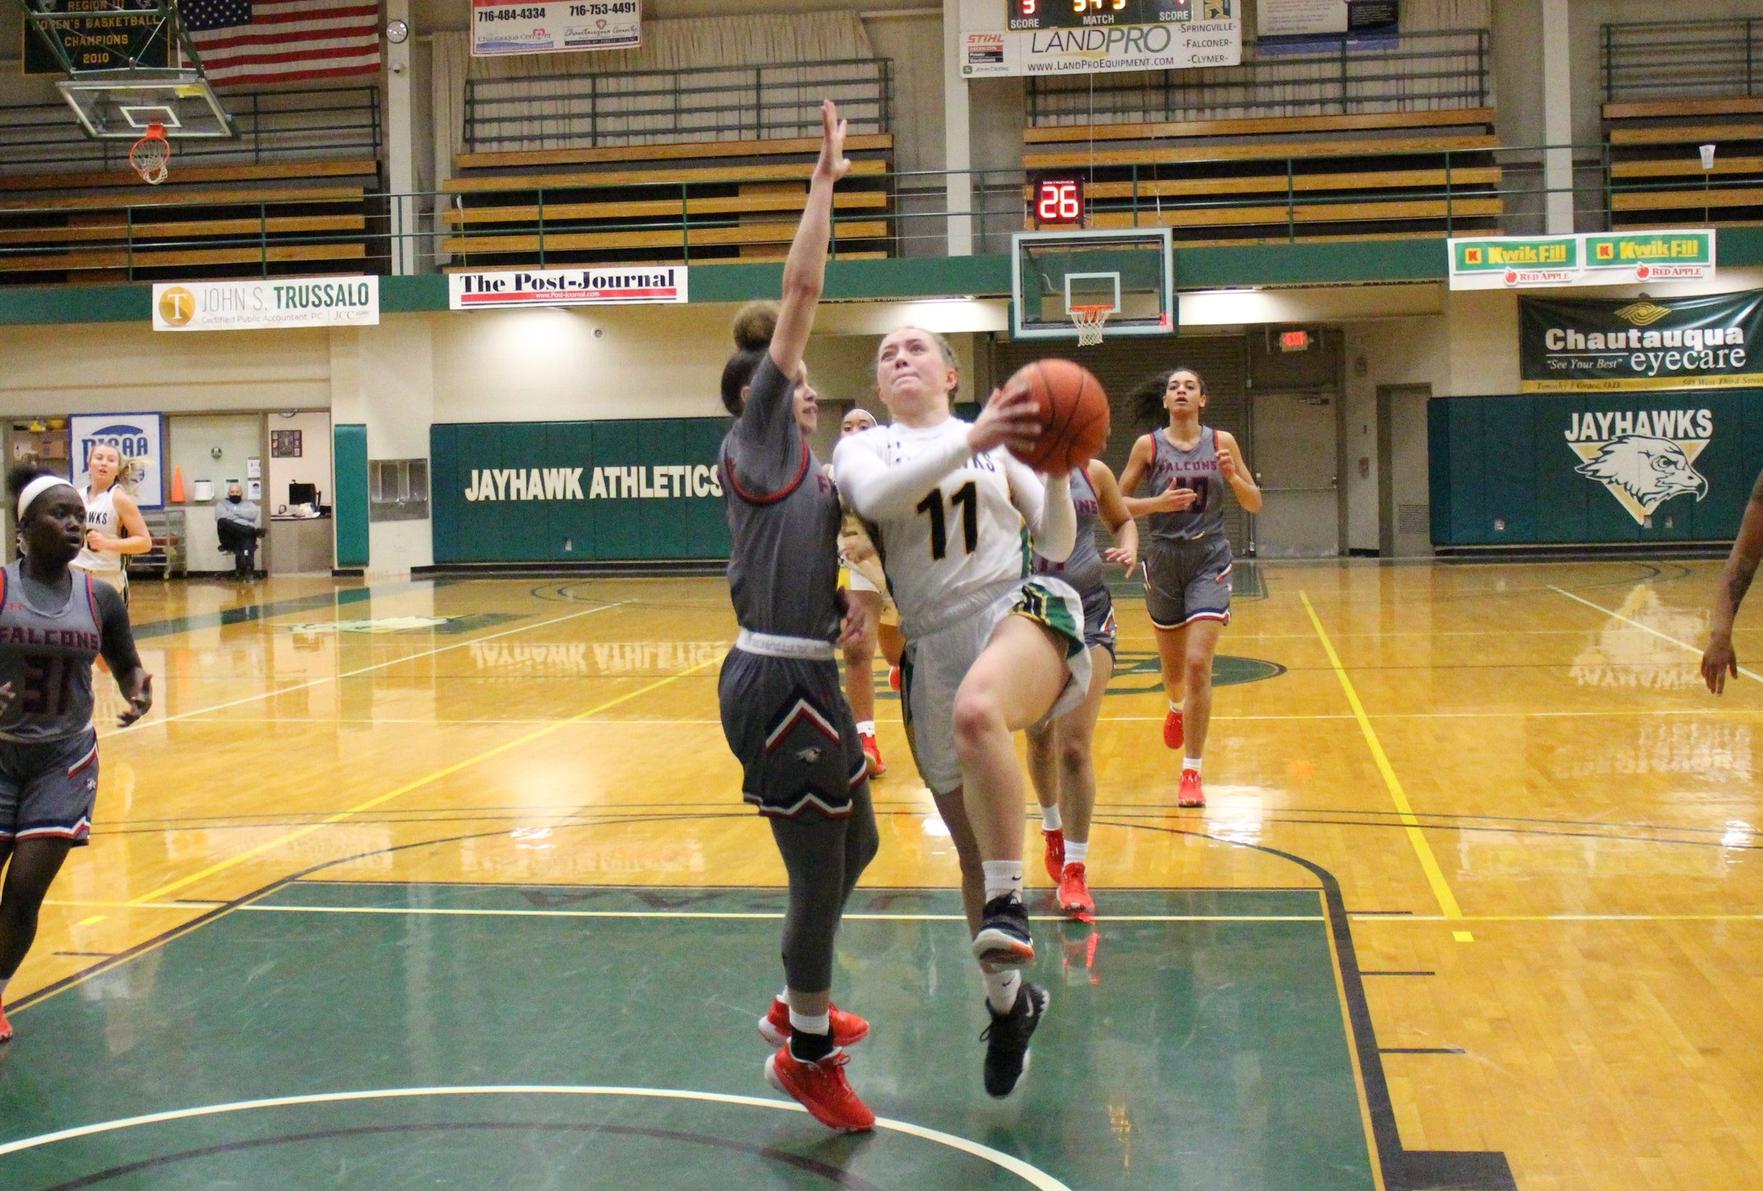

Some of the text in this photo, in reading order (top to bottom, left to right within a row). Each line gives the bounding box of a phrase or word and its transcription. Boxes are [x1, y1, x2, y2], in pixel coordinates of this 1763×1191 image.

[478, 8, 546, 22] 716-484-4334
[569, 2, 636, 17] 716-753-4491
[1159, 10, 1189, 21] SCORE
[37, 15, 160, 30] OEN'S BASKETBALL
[1010, 19, 1040, 29] SCORE
[1082, 14, 1115, 25] MATCH
[64, 35, 129, 48] CHAMPIONS
[967, 34, 1005, 43] STIHL
[1031, 25, 1172, 54] LANDPRO
[83, 53, 110, 64] 2010
[1040, 185, 1079, 218] 26
[1487, 246, 1538, 265] Kwik
[1539, 244, 1567, 263] Fill
[1620, 240, 1670, 260] Kwik
[1670, 239, 1699, 258] Fill
[1520, 271, 1569, 281] RED APPLE
[1652, 267, 1702, 276] RED APPLE
[459, 269, 675, 293] The Post-Journal
[202, 282, 370, 313] JOHN S. TRUSSALO
[535, 290, 600, 299] www.Post-Journal.com
[237, 314, 258, 324] Public
[311, 311, 322, 320] PC
[1544, 326, 1745, 351] Chautauqua
[1570, 359, 1594, 370] Your
[1630, 348, 1747, 376] eyecare
[1563, 409, 1713, 442] JAYHAWKS
[464, 464, 723, 502] JAYHAWK ATHLETICS
[917, 481, 979, 562] 11
